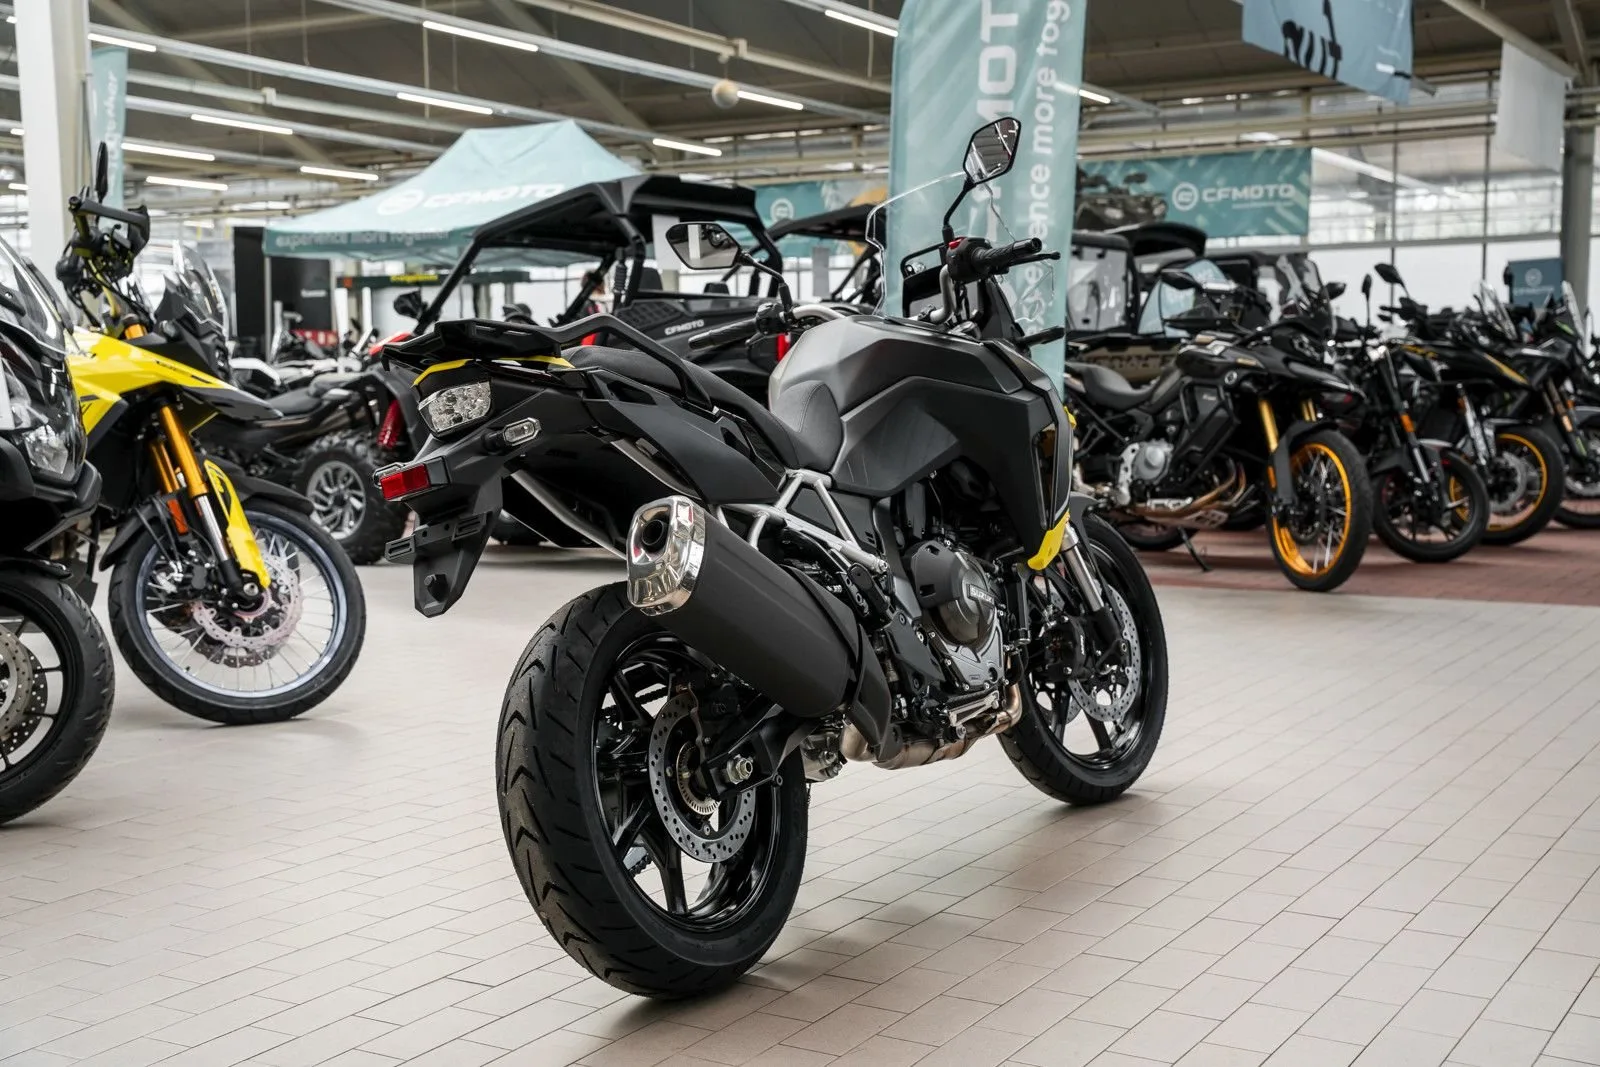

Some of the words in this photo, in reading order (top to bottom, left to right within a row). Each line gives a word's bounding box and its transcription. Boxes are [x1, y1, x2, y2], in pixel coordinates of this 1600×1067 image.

[1036, 0, 1071, 57] tog
[1033, 66, 1059, 155] more
[1202, 184, 1296, 202] CFMOTO
[664, 319, 704, 335] CFMOTO
